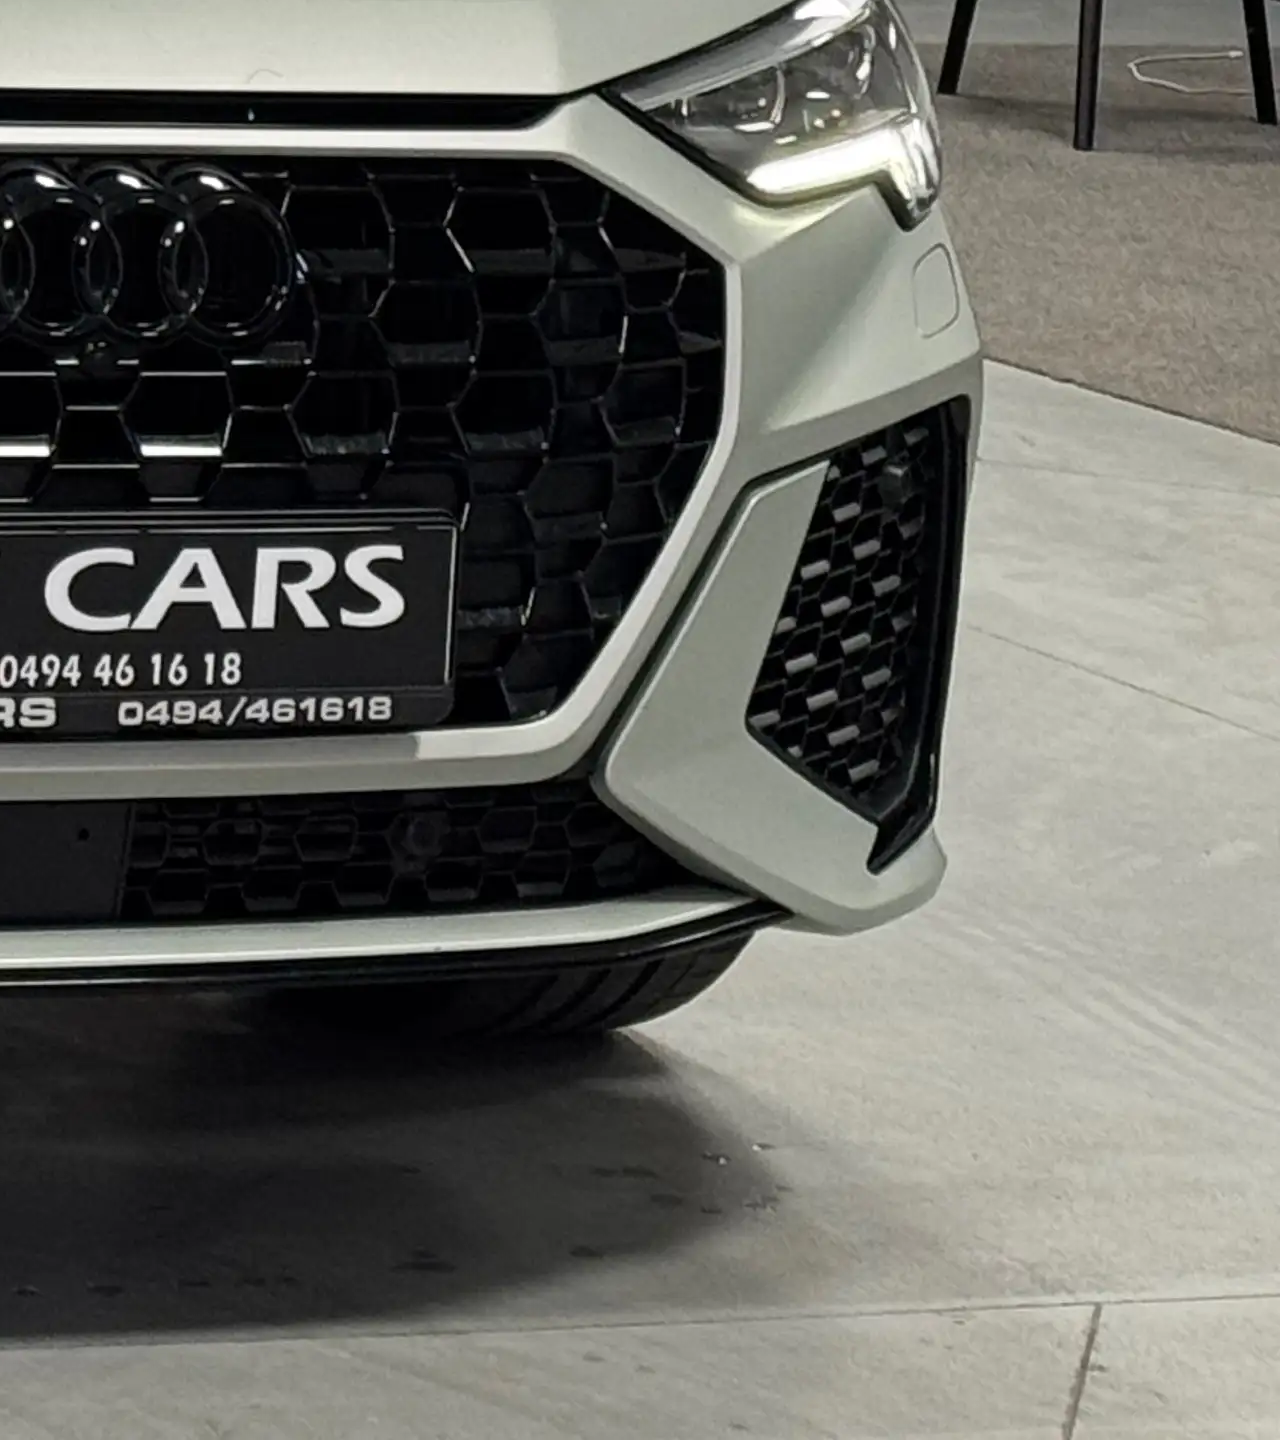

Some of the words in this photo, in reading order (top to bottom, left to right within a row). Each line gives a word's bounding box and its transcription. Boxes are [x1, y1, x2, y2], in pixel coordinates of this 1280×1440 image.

[44, 545, 405, 631] CARS
[93, 653, 135, 687] 46
[151, 653, 188, 686] 16
[204, 651, 241, 686] 18
[118, 695, 392, 727] 0494/461618
